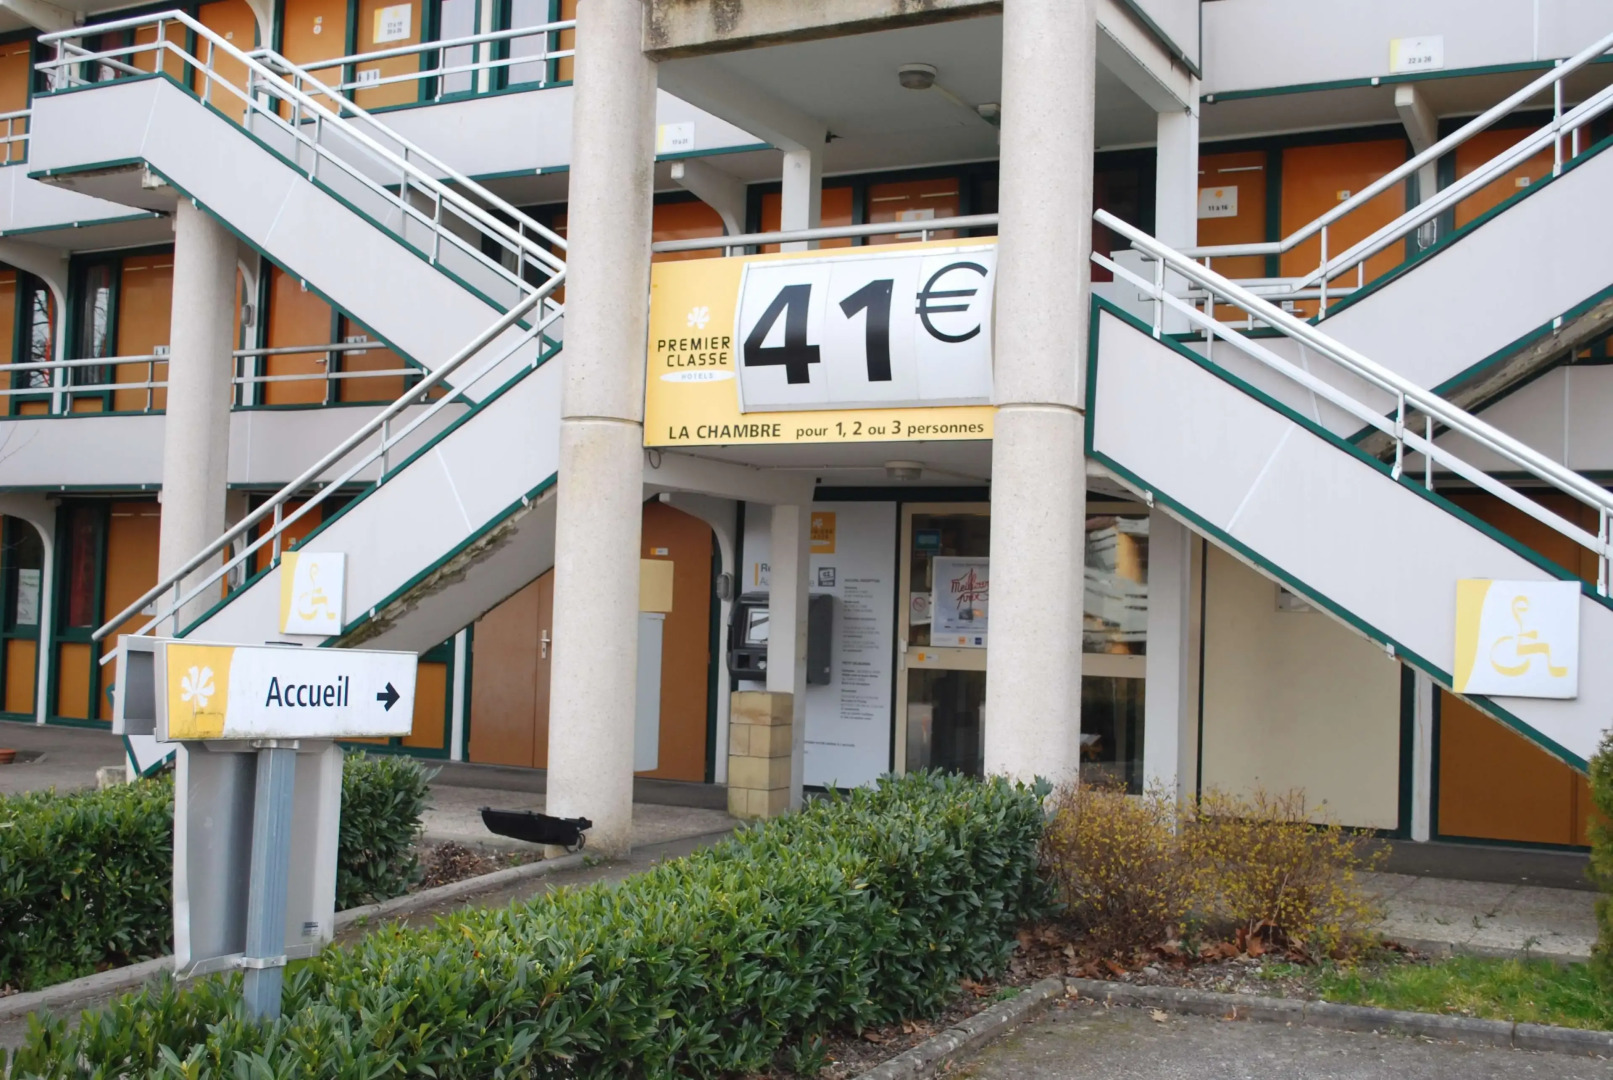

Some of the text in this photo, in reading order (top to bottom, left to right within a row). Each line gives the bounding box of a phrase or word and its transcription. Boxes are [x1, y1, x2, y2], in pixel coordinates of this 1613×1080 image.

[657, 336, 731, 353] PREMIER
[667, 352, 728, 368] CLASSE
[681, 372, 714, 381] HOTELS
[669, 420, 984, 440] LA CHAMBRE pour 1, 2 ou 3 personnes
[265, 675, 350, 708] Accueil
